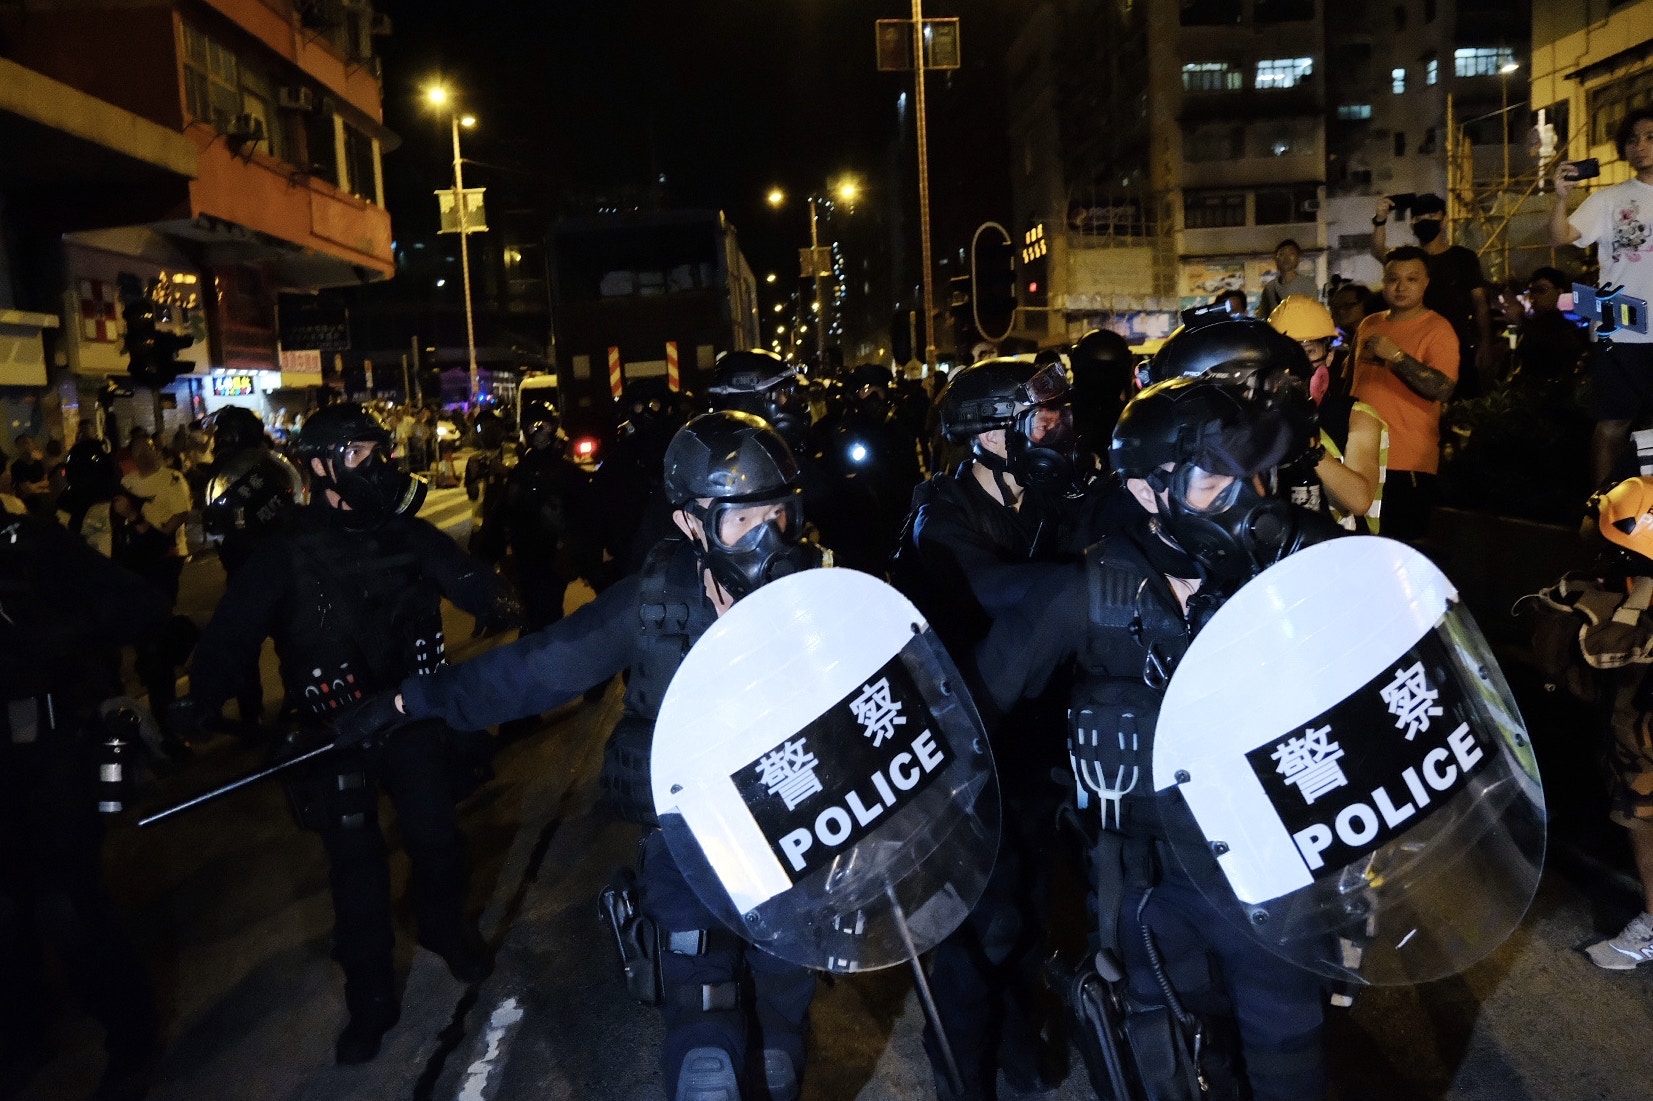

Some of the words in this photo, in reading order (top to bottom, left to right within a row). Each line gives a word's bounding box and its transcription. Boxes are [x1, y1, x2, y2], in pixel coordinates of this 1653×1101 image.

[755, 677, 907, 812] 警察
[778, 728, 945, 872] POLICE
[1270, 661, 1443, 805] 警察
[1292, 721, 1484, 871] POLICE
